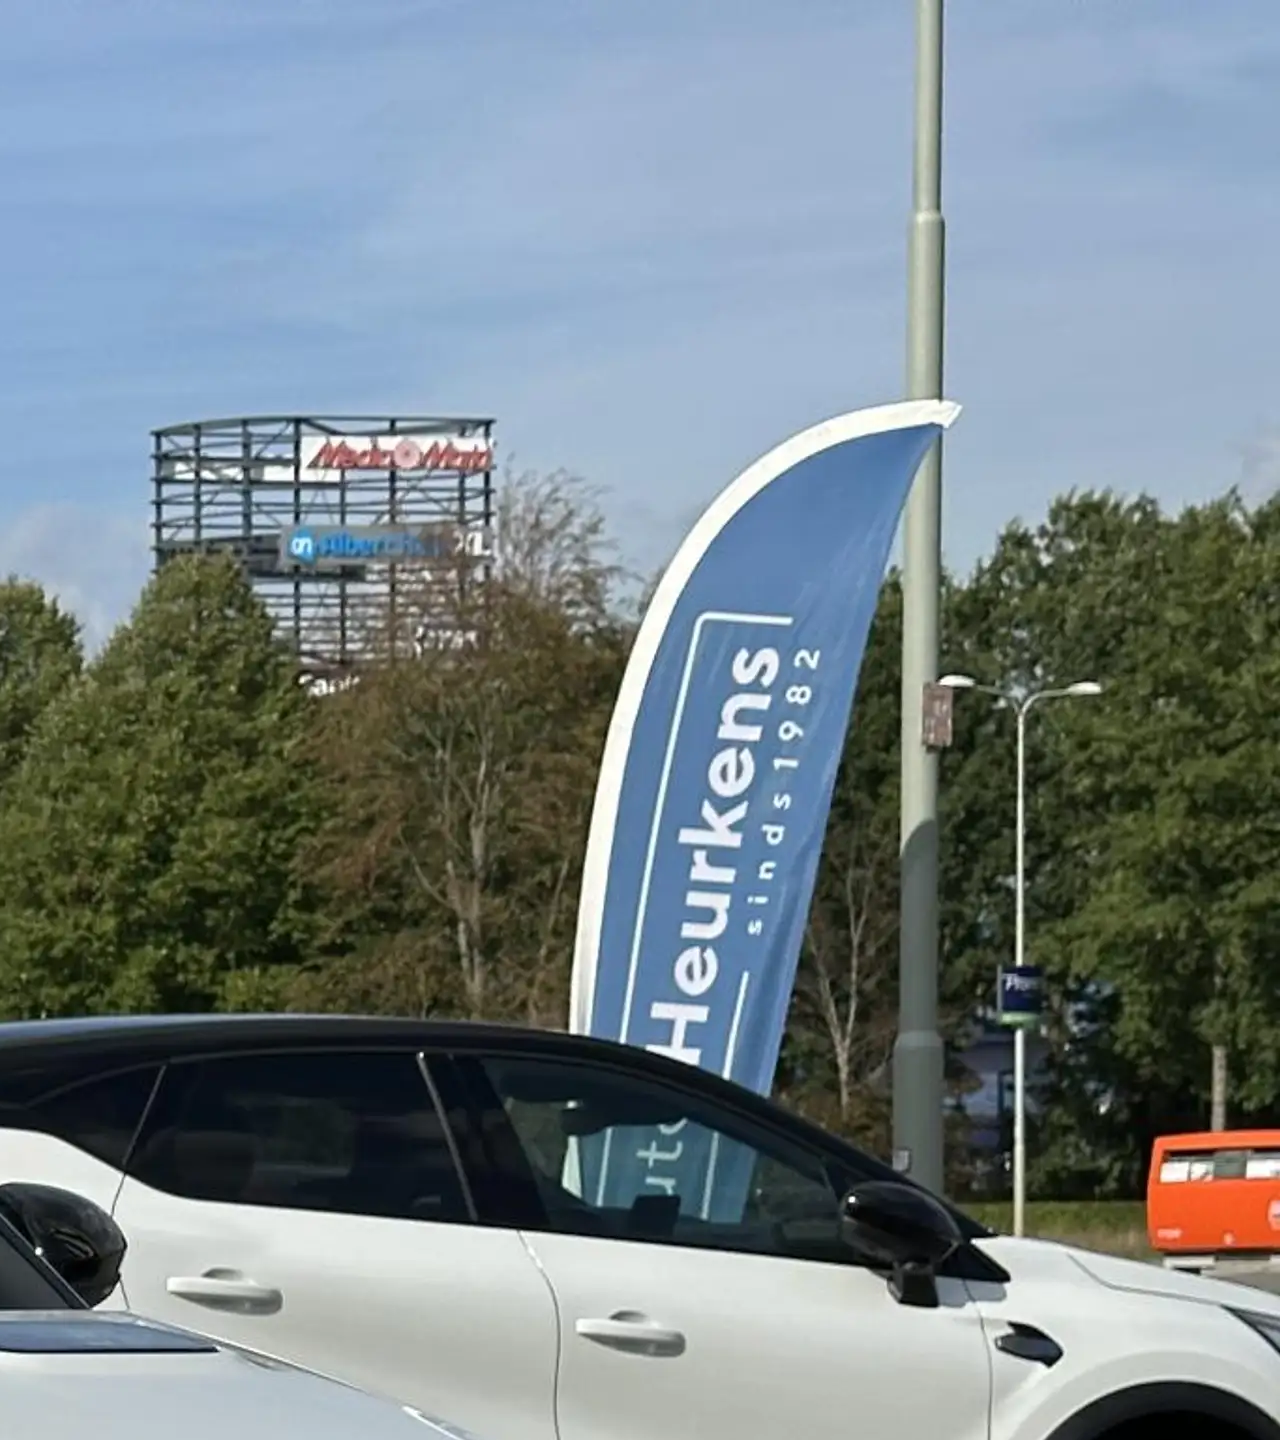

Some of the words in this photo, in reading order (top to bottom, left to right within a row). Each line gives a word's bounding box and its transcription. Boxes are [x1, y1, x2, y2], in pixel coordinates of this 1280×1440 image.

[645, 647, 780, 1066] Heurkens
[747, 793, 792, 936] sinds
[773, 649, 821, 771] 1982
